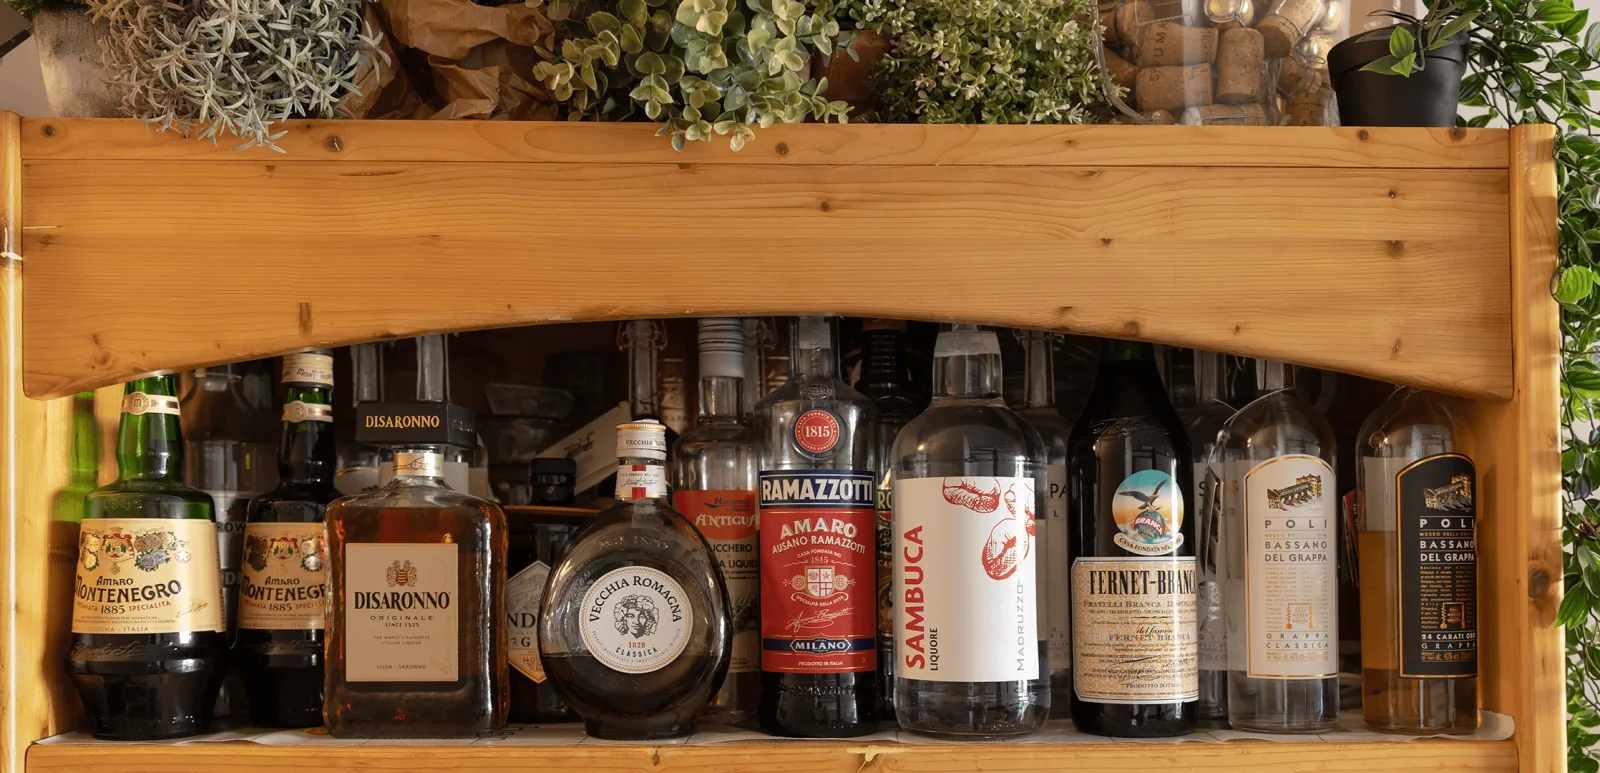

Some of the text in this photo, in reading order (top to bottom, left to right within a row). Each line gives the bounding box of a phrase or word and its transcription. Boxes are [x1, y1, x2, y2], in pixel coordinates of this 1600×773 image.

[365, 415, 440, 429] DISARONNO
[804, 425, 830, 438] 1815
[762, 478, 873, 501] RAMAZZOTTI
[780, 517, 858, 540] AMARO
[1135, 517, 1163, 536] BRANCA
[1264, 519, 1327, 529] POLI
[1419, 518, 1474, 528] POLI
[772, 535, 866, 555] AUSANO RAMAZZOTTI
[1119, 537, 1134, 549] CASA
[1134, 545, 1161, 553] FONDATA
[1265, 541, 1328, 550] BASSANO
[1420, 540, 1475, 549] BASSANO
[811, 556, 829, 564] 1815
[1264, 553, 1328, 562] DEL GRAPPA
[1420, 553, 1475, 562] DEL GRAPPA
[96, 575, 134, 586] AMARO
[264, 575, 300, 586] AMARO
[1089, 570, 1196, 595] FERNET-BRANC
[74, 573, 182, 604] MONTENEGRO
[353, 591, 450, 611] DISARONNO
[589, 575, 682, 623] VECCHIA ROMAGNA
[903, 525, 926, 670] SAMBUCA
[1083, 600, 1123, 608] FRATELLI
[1125, 600, 1162, 608] BRANCA
[100, 604, 126, 614] 1885
[128, 600, 171, 612] SPECIALITA
[268, 603, 292, 612] 1885
[295, 600, 325, 610] SPECIALI
[1016, 584, 1024, 671] MADRUZZO
[1136, 626, 1149, 634] del
[615, 646, 658, 658] CLASSICA
[795, 642, 846, 650] MILANO
[929, 628, 940, 671] LIQUORE
